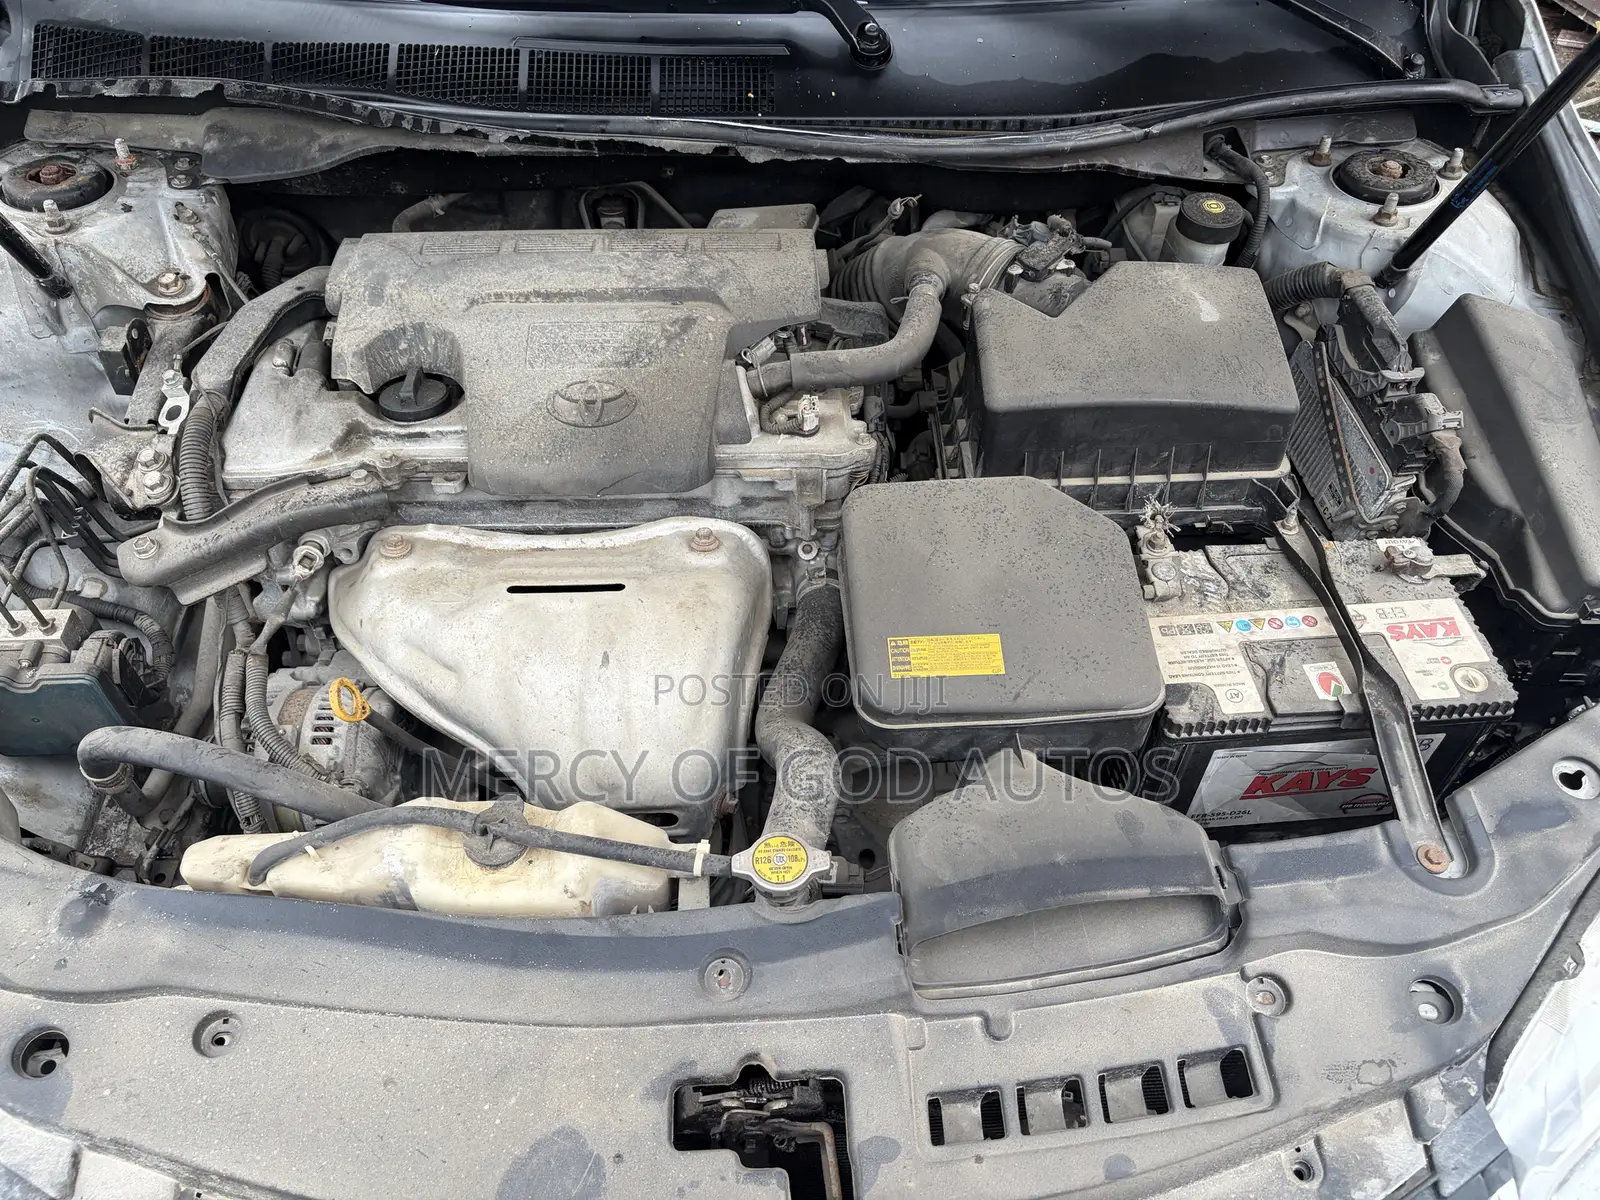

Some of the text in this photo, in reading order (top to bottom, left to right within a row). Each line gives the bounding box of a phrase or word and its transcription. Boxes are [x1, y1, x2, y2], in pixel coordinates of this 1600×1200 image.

[1386, 620, 1462, 641] KAYS
[1243, 767, 1379, 795] KAYS
[755, 856, 772, 865] R126
